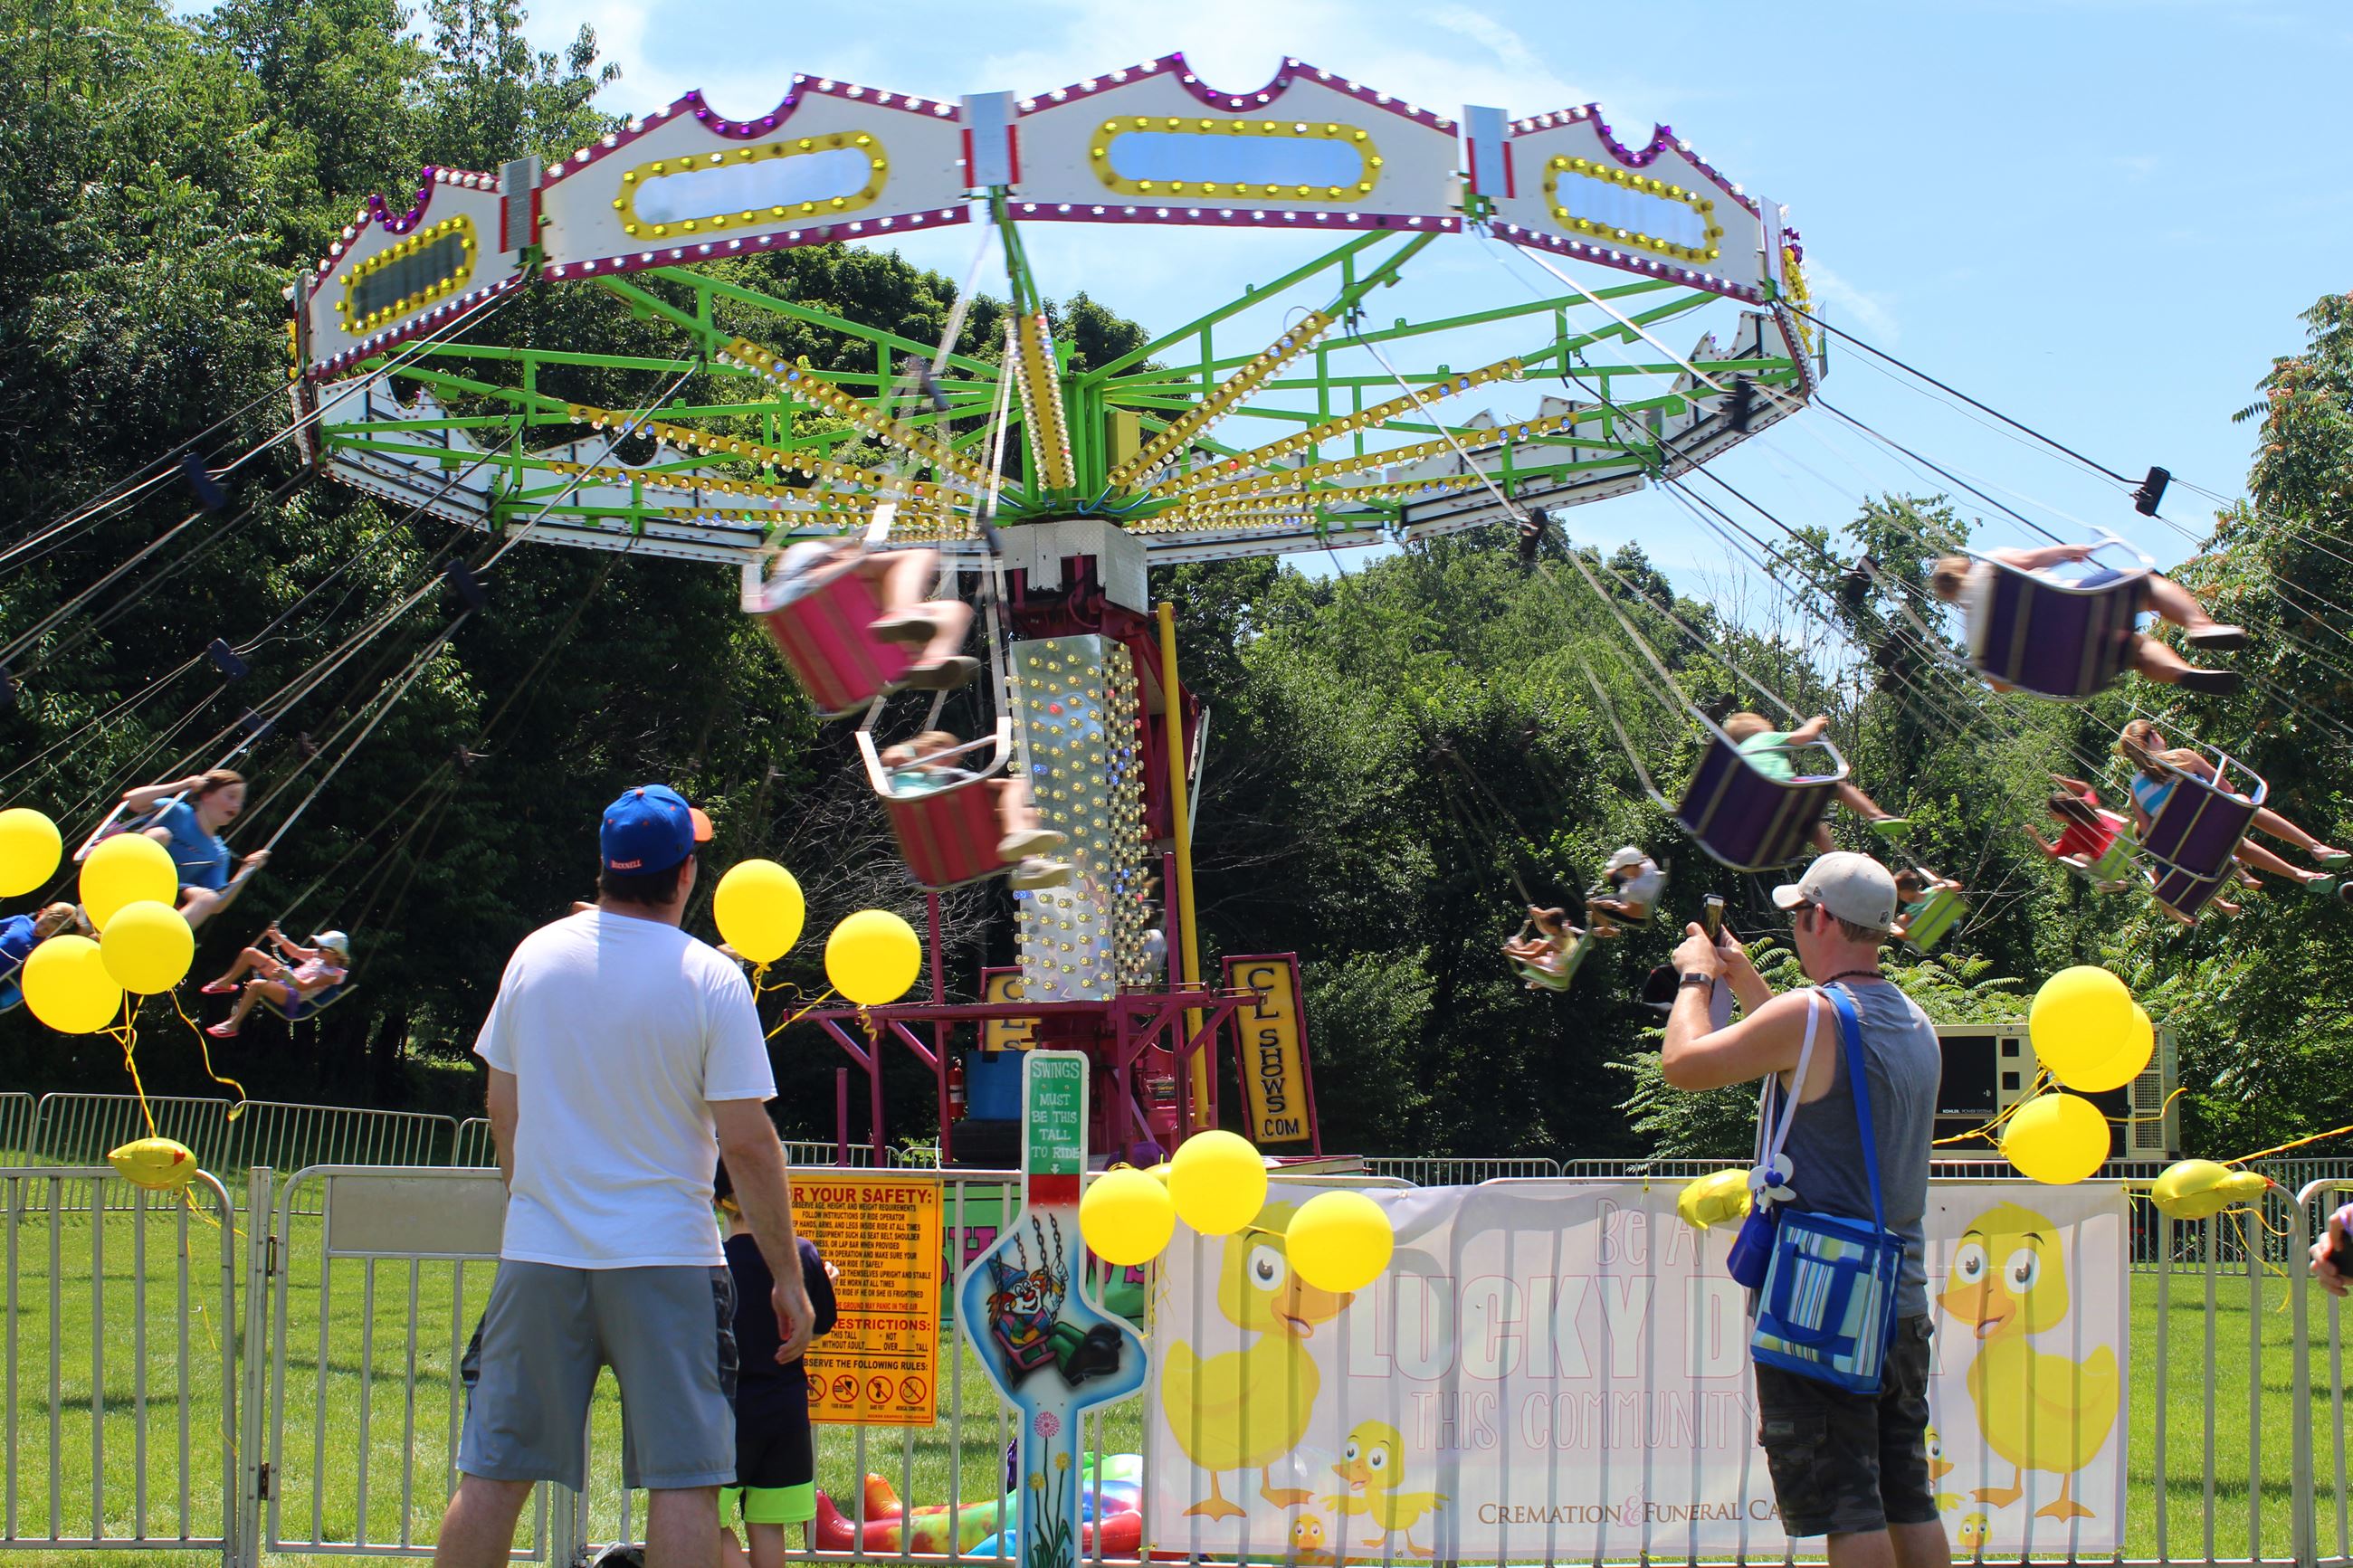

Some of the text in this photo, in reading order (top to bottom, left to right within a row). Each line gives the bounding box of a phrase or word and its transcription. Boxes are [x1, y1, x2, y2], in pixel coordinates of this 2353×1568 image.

[1032, 1061, 1079, 1079] SWINGS
[1258, 1028, 1286, 1115] SHOWS
[1039, 1094, 1070, 1106] MUST
[1032, 1111, 1077, 1123] BE THIS
[1261, 1117, 1299, 1136] .COM
[1039, 1129, 1071, 1140] TALL
[1031, 1146, 1079, 1158] TO RIDE
[810, 1187, 856, 1202] YOUR
[862, 1188, 931, 1203] SAFETY:
[823, 1212, 858, 1220] INSTRUCTIONS
[907, 1223, 920, 1231] TIMES
[816, 1231, 843, 1239] EQUIPMENT
[845, 1231, 858, 1239] SUCH
[867, 1231, 879, 1240] SEAT
[895, 1232, 919, 1240] SHOULDER
[832, 1240, 837, 1248] OR
[835, 1250, 862, 1258] OPERATION
[890, 1251, 902, 1259] SURE
[847, 1269, 878, 1278] THEMSELVES
[880, 1270, 900, 1278] UPRIGHT
[913, 1271, 931, 1279] STABLE
[893, 1290, 923, 1298] FRIGHTENED
[1348, 1275, 1656, 1381] LUCKY
[831, 1330, 857, 1340] THIS TALL
[886, 1333, 897, 1341] NOT
[822, 1340, 865, 1350] WITHOUT ADULT
[883, 1343, 898, 1351] OVER
[916, 1344, 929, 1352] TALL
[804, 1358, 928, 1371] BSERVE THE FOLLOWING RULES:
[1411, 1391, 1761, 1452] THIS COMMUNITY
[1477, 1502, 1622, 1525] CREMATION
[1643, 1500, 1742, 1523] FUNERAL
